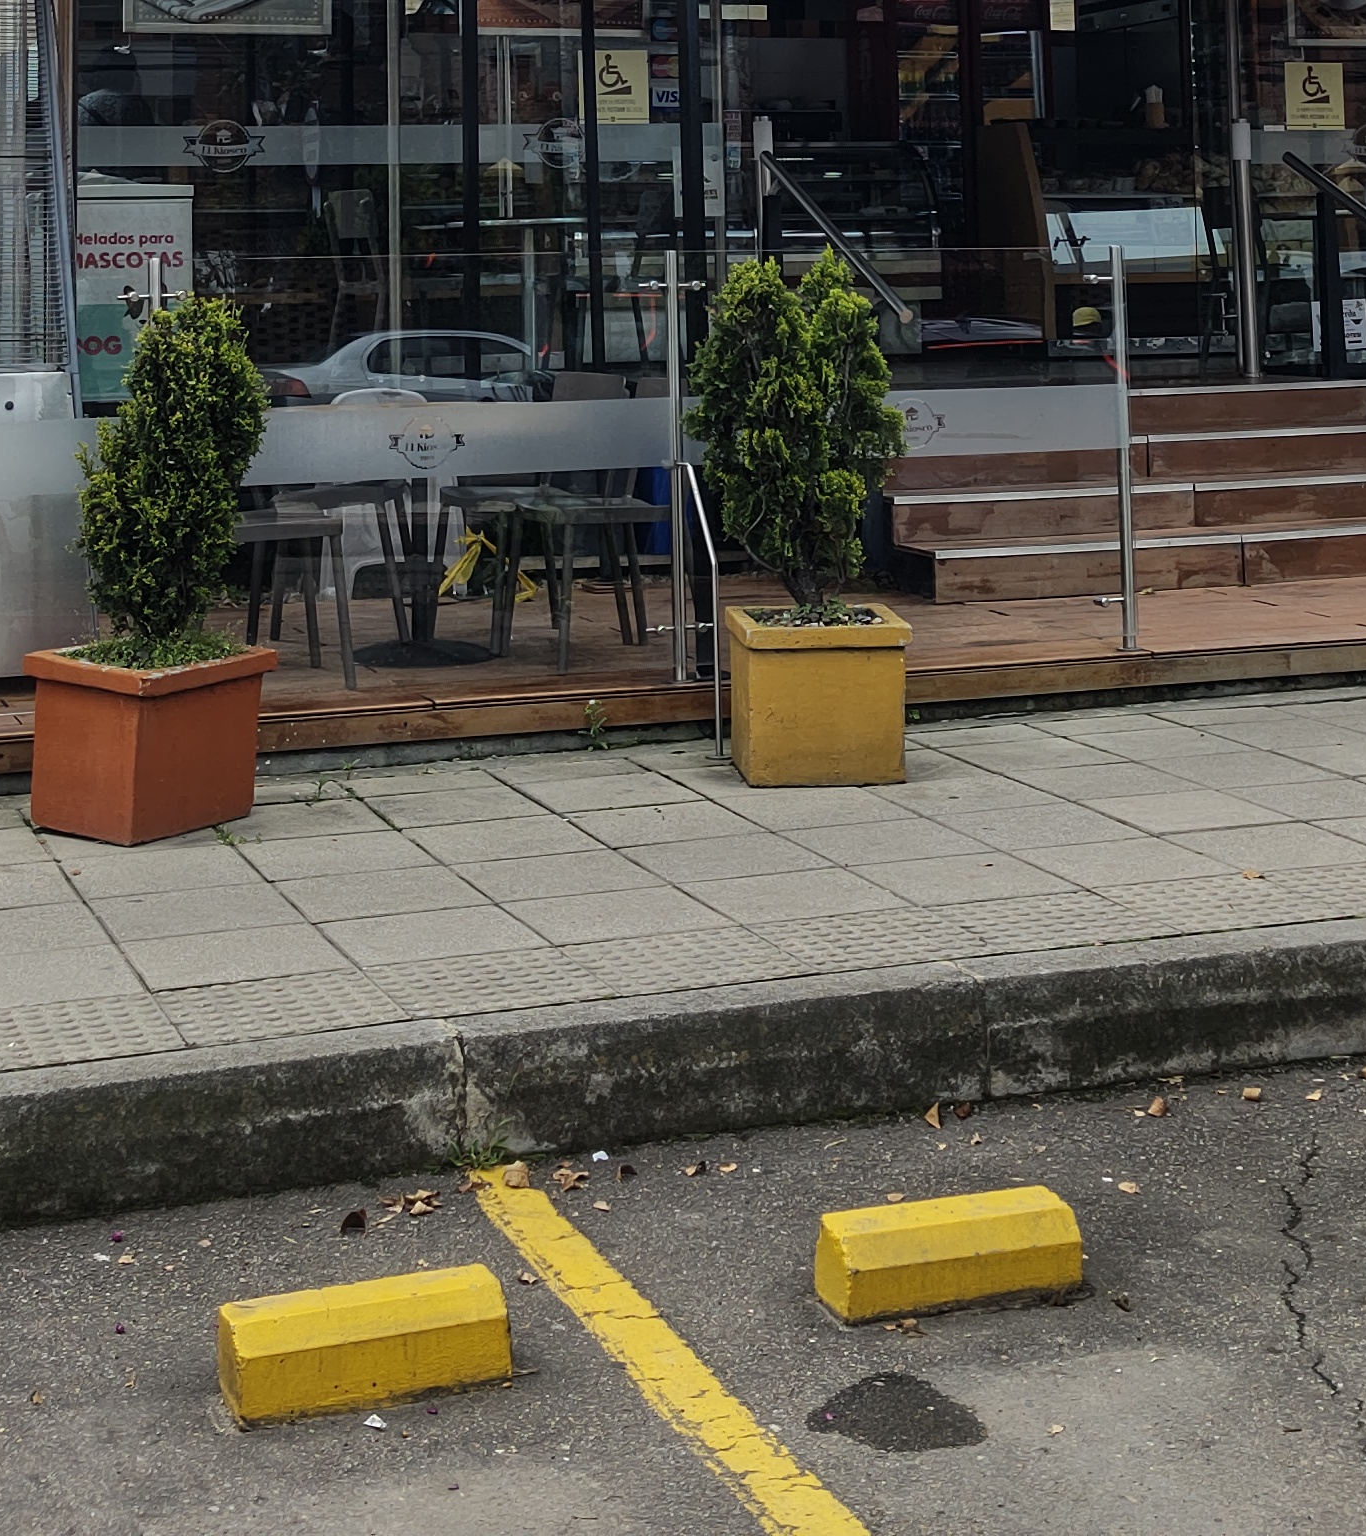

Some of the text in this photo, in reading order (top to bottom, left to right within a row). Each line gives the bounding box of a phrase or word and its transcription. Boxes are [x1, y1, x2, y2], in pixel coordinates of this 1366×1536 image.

[656, 90, 680, 103] VIS
[138, 234, 174, 248] para
[77, 335, 122, 356] OG
